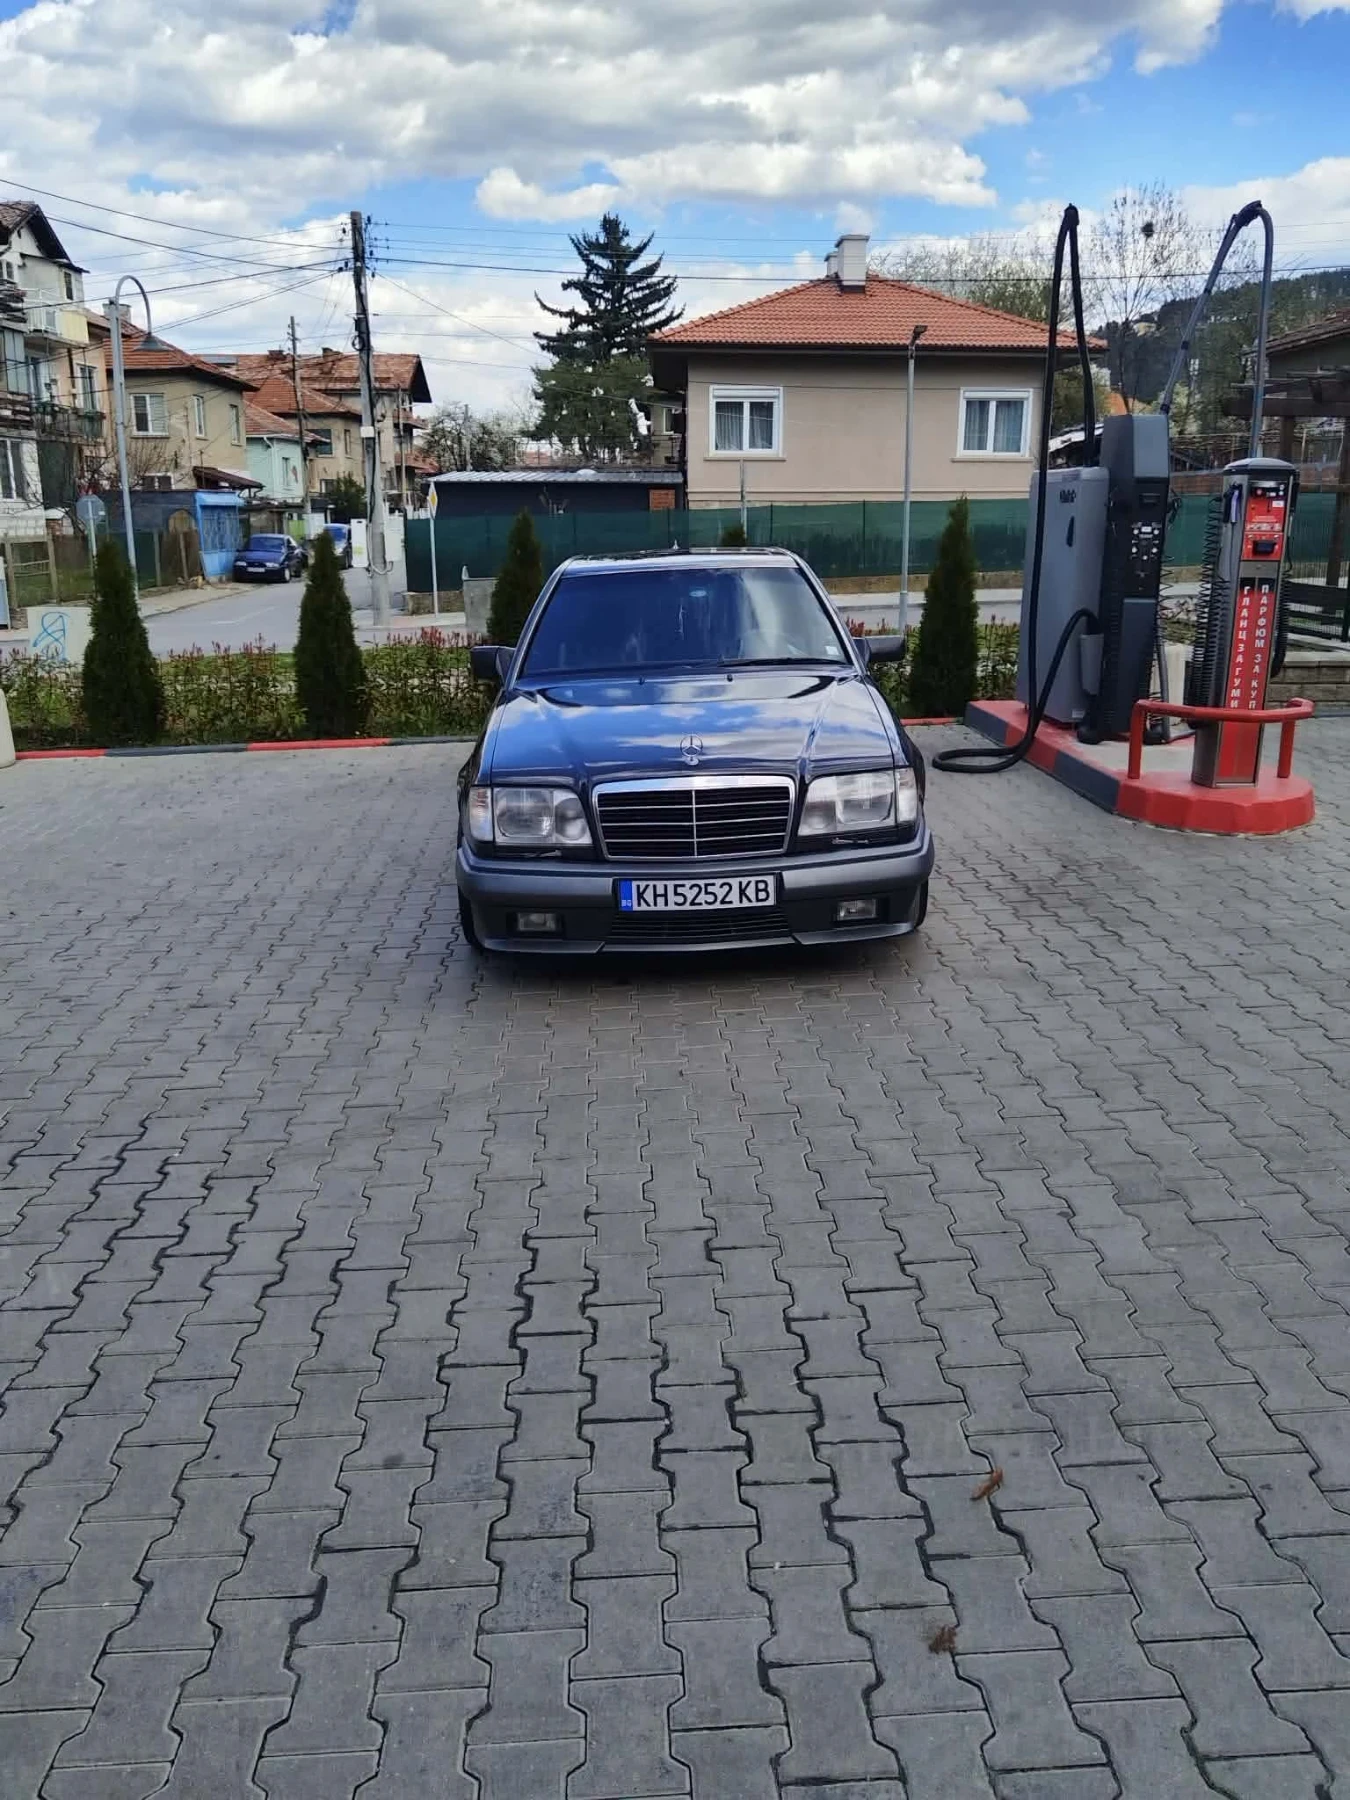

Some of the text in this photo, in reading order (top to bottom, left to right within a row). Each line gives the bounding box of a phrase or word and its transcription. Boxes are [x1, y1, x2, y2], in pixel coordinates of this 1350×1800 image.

[1230, 586, 1251, 708] ГЛАНЦ ЗА ГУМИ
[1255, 584, 1270, 648] ПАРФЮМ
[1253, 653, 1262, 674] ЗА
